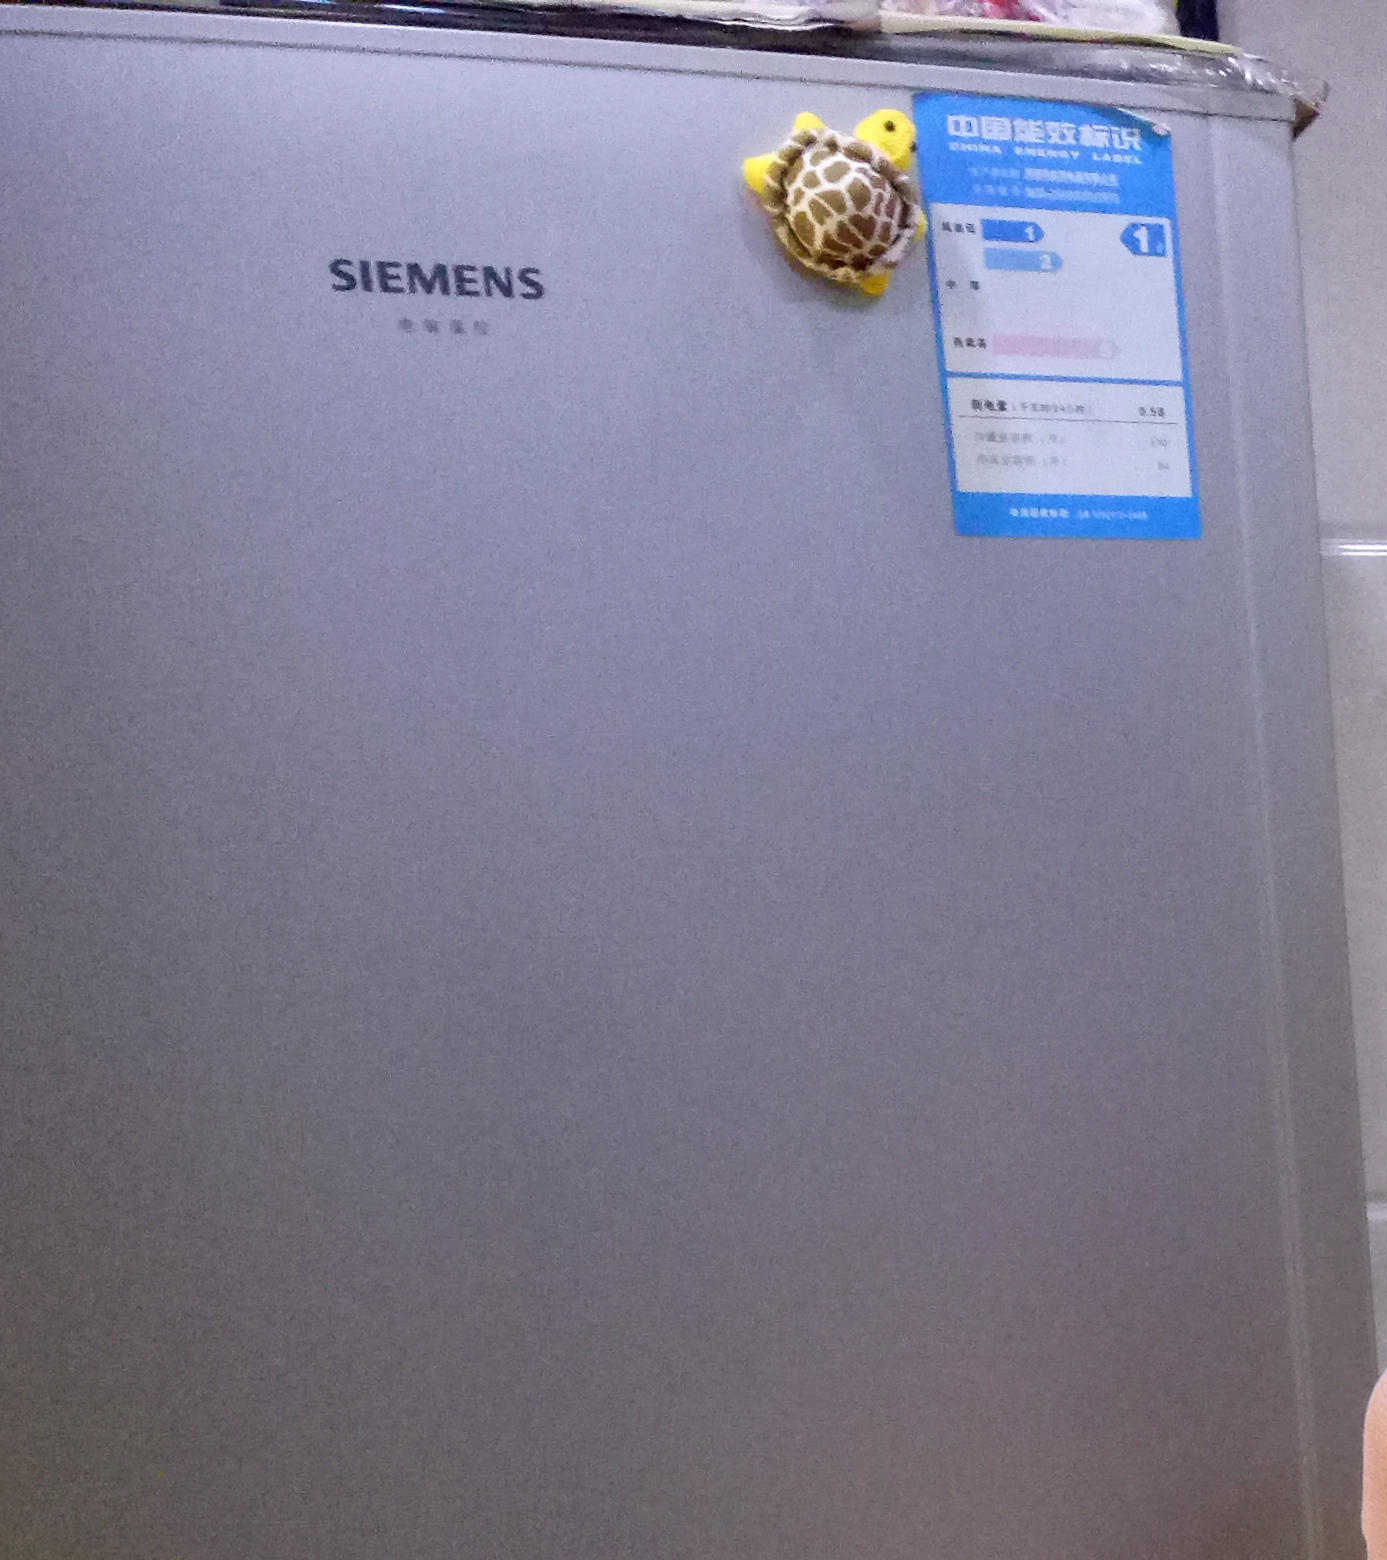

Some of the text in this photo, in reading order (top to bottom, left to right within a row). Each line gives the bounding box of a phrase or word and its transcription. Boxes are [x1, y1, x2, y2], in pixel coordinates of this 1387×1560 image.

[947, 114, 1142, 151] 中国能效标识
[950, 142, 1142, 165] CHINA ENERGY LABEL
[1133, 225, 1150, 254] 1
[329, 258, 546, 300] SIEMENS
